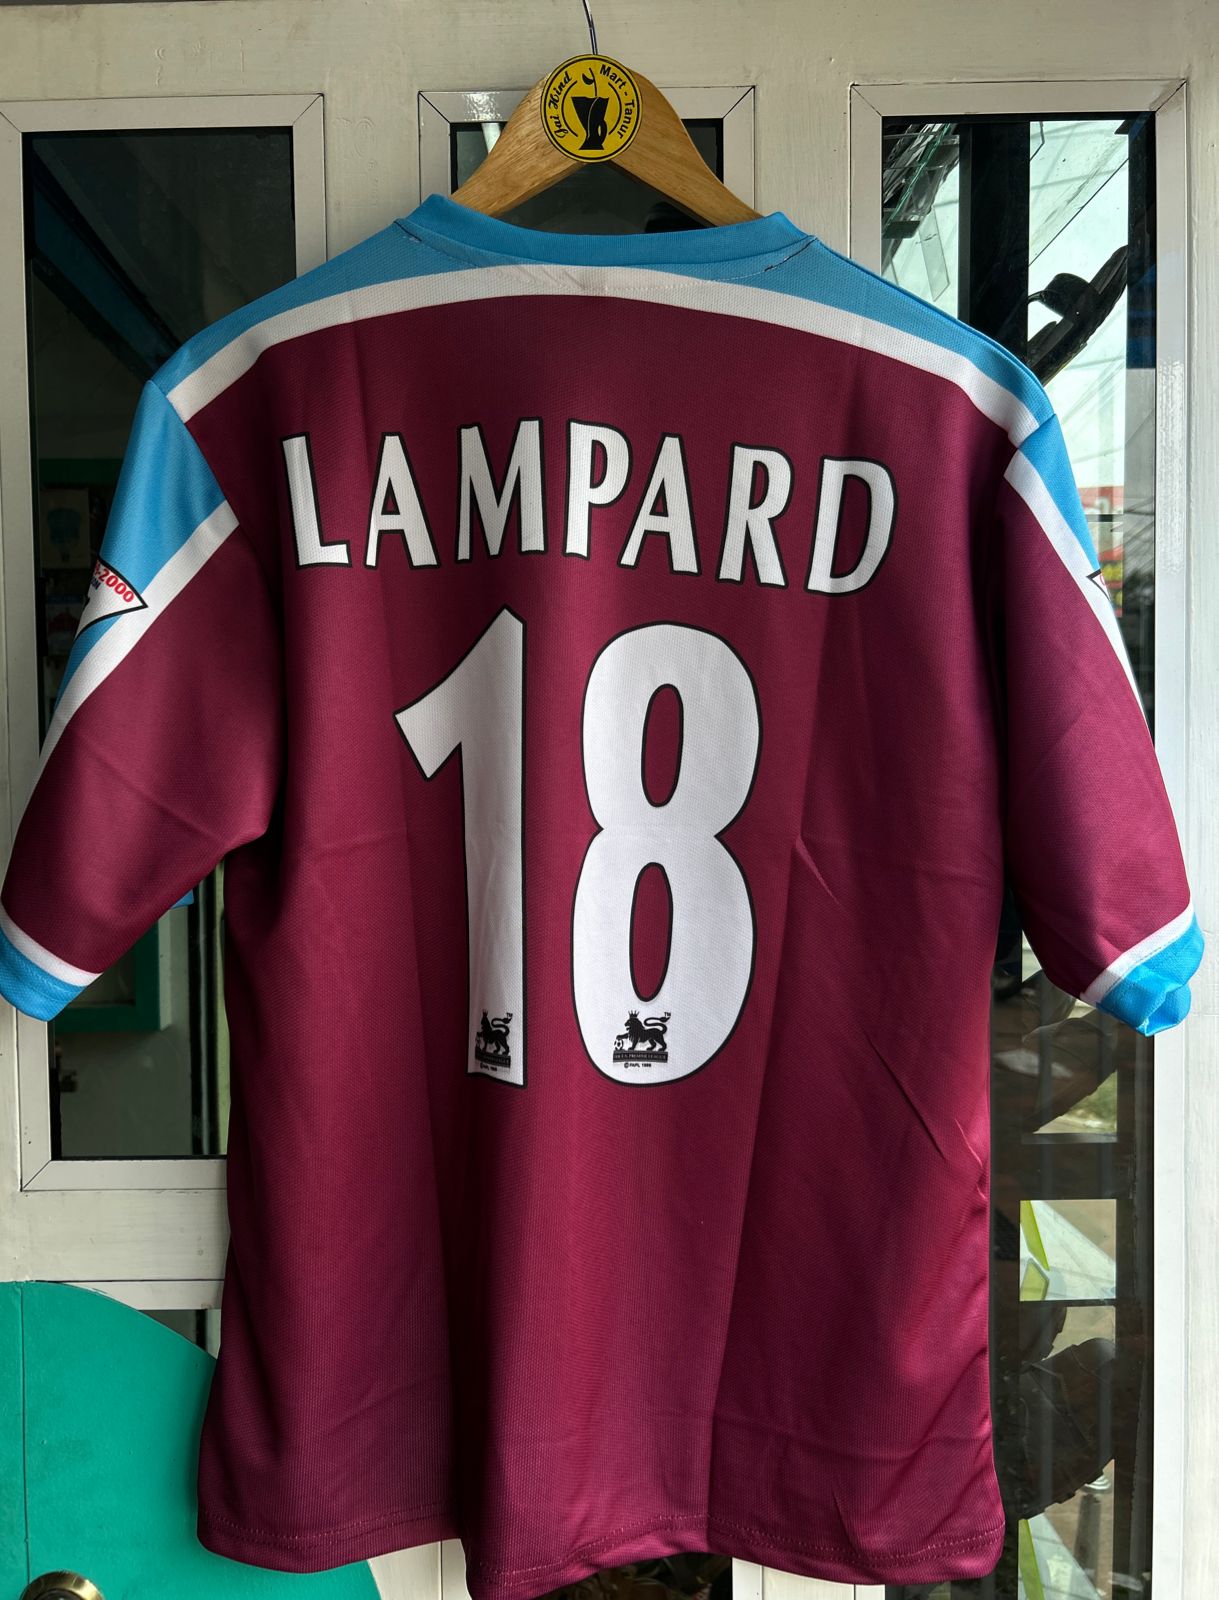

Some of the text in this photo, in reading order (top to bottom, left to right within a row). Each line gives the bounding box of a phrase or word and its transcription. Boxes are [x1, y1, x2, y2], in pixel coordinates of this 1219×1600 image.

[548, 70, 573, 110] Hind
[599, 64, 627, 90] Mart
[616, 99, 636, 139] Tanur
[281, 417, 897, 596] LAMPARD
[393, 605, 764, 1088] 18
